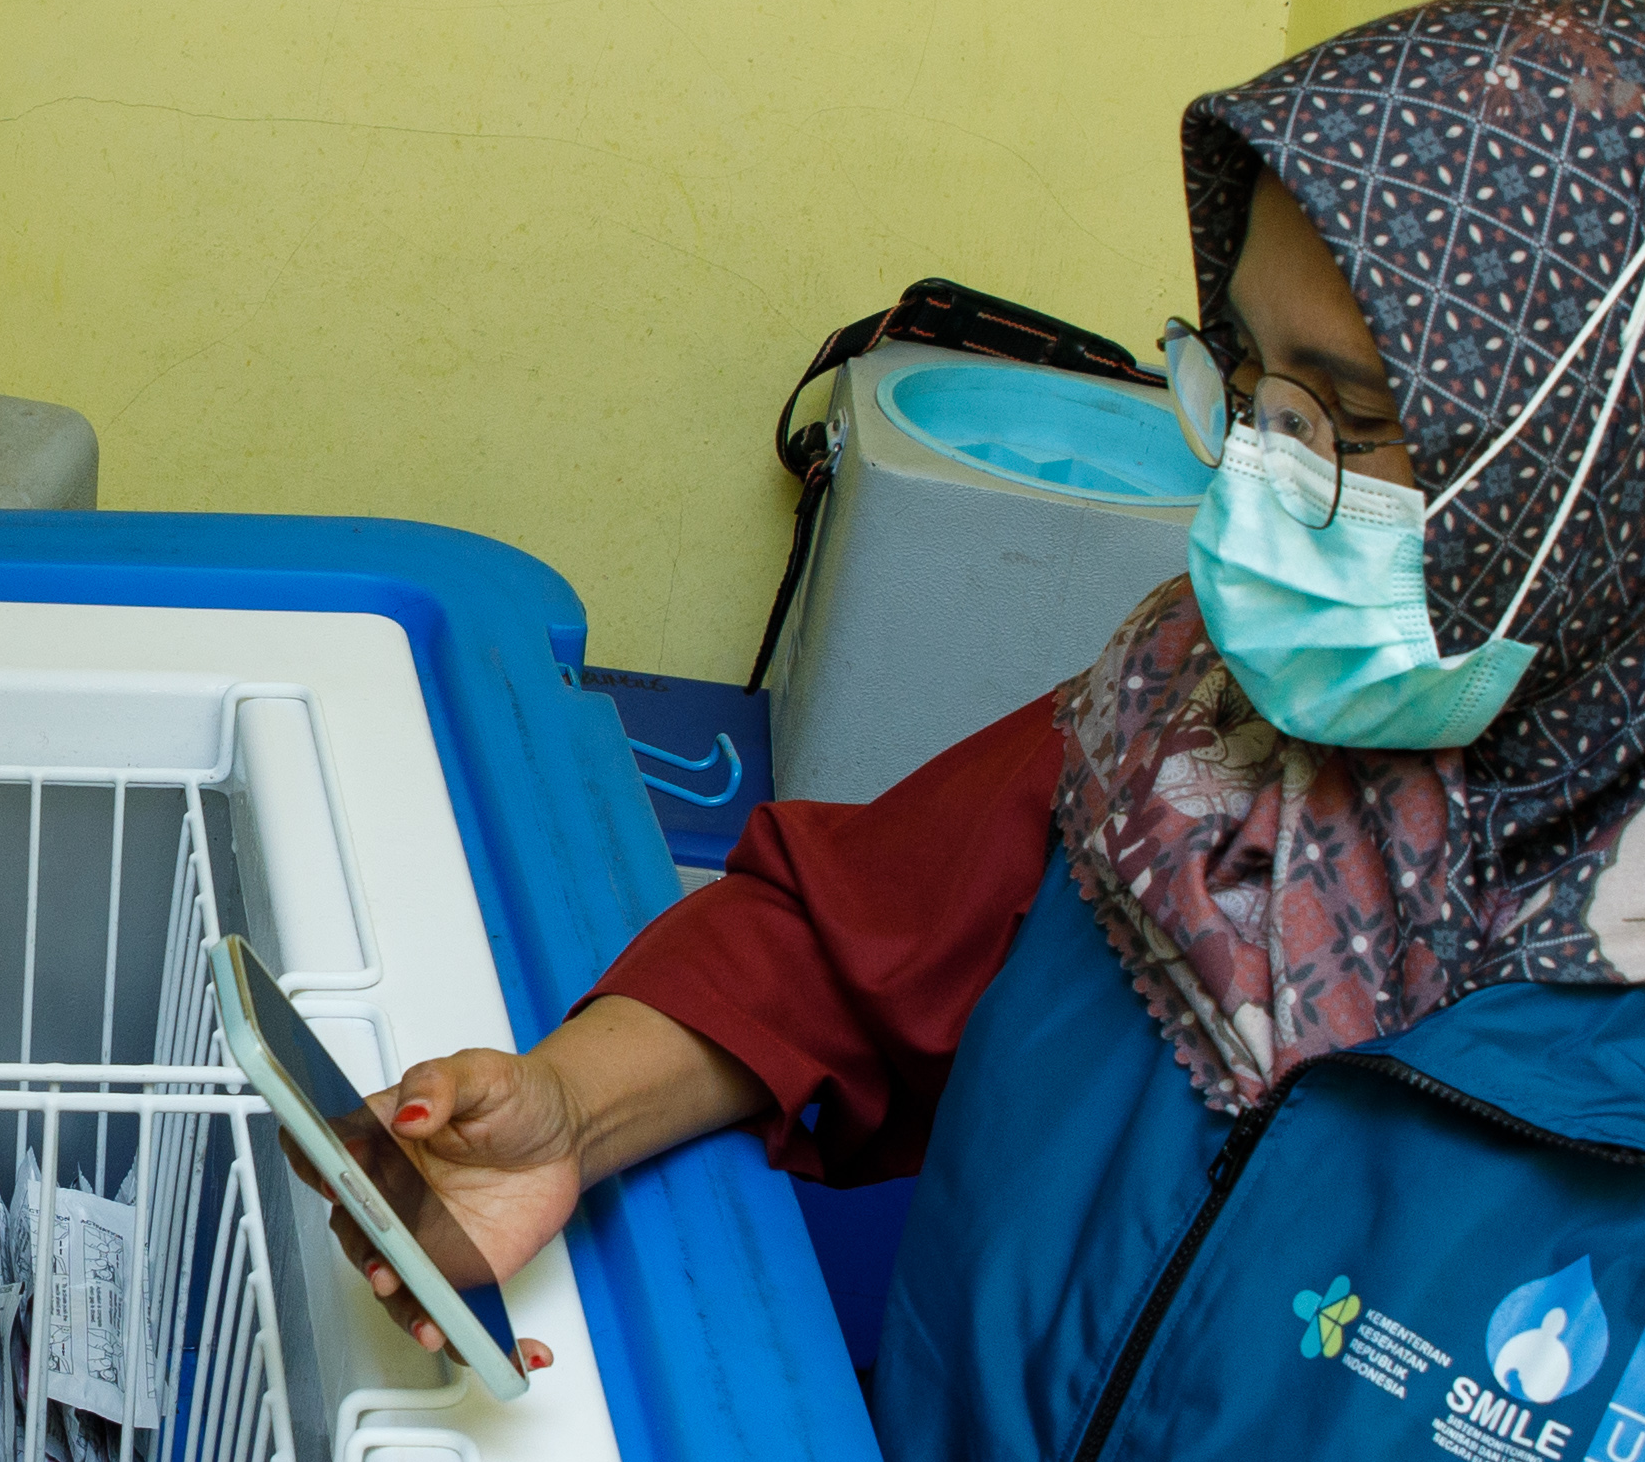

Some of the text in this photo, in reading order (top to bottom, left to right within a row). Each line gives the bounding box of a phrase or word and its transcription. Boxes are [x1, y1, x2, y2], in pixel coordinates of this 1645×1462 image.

[1349, 1337, 1409, 1381] REPUBLIK
[1357, 1323, 1429, 1373] KESEHATAN
[1365, 1308, 1453, 1369] KEMENTERIAN
[1341, 1352, 1407, 1400] INDONESIA
[1445, 1376, 1573, 1461] SMILE
[1446, 1413, 1482, 1439] SISTEM
[1432, 1431, 1473, 1462] SECARA
[1477, 1444, 1502, 1462] DAN
